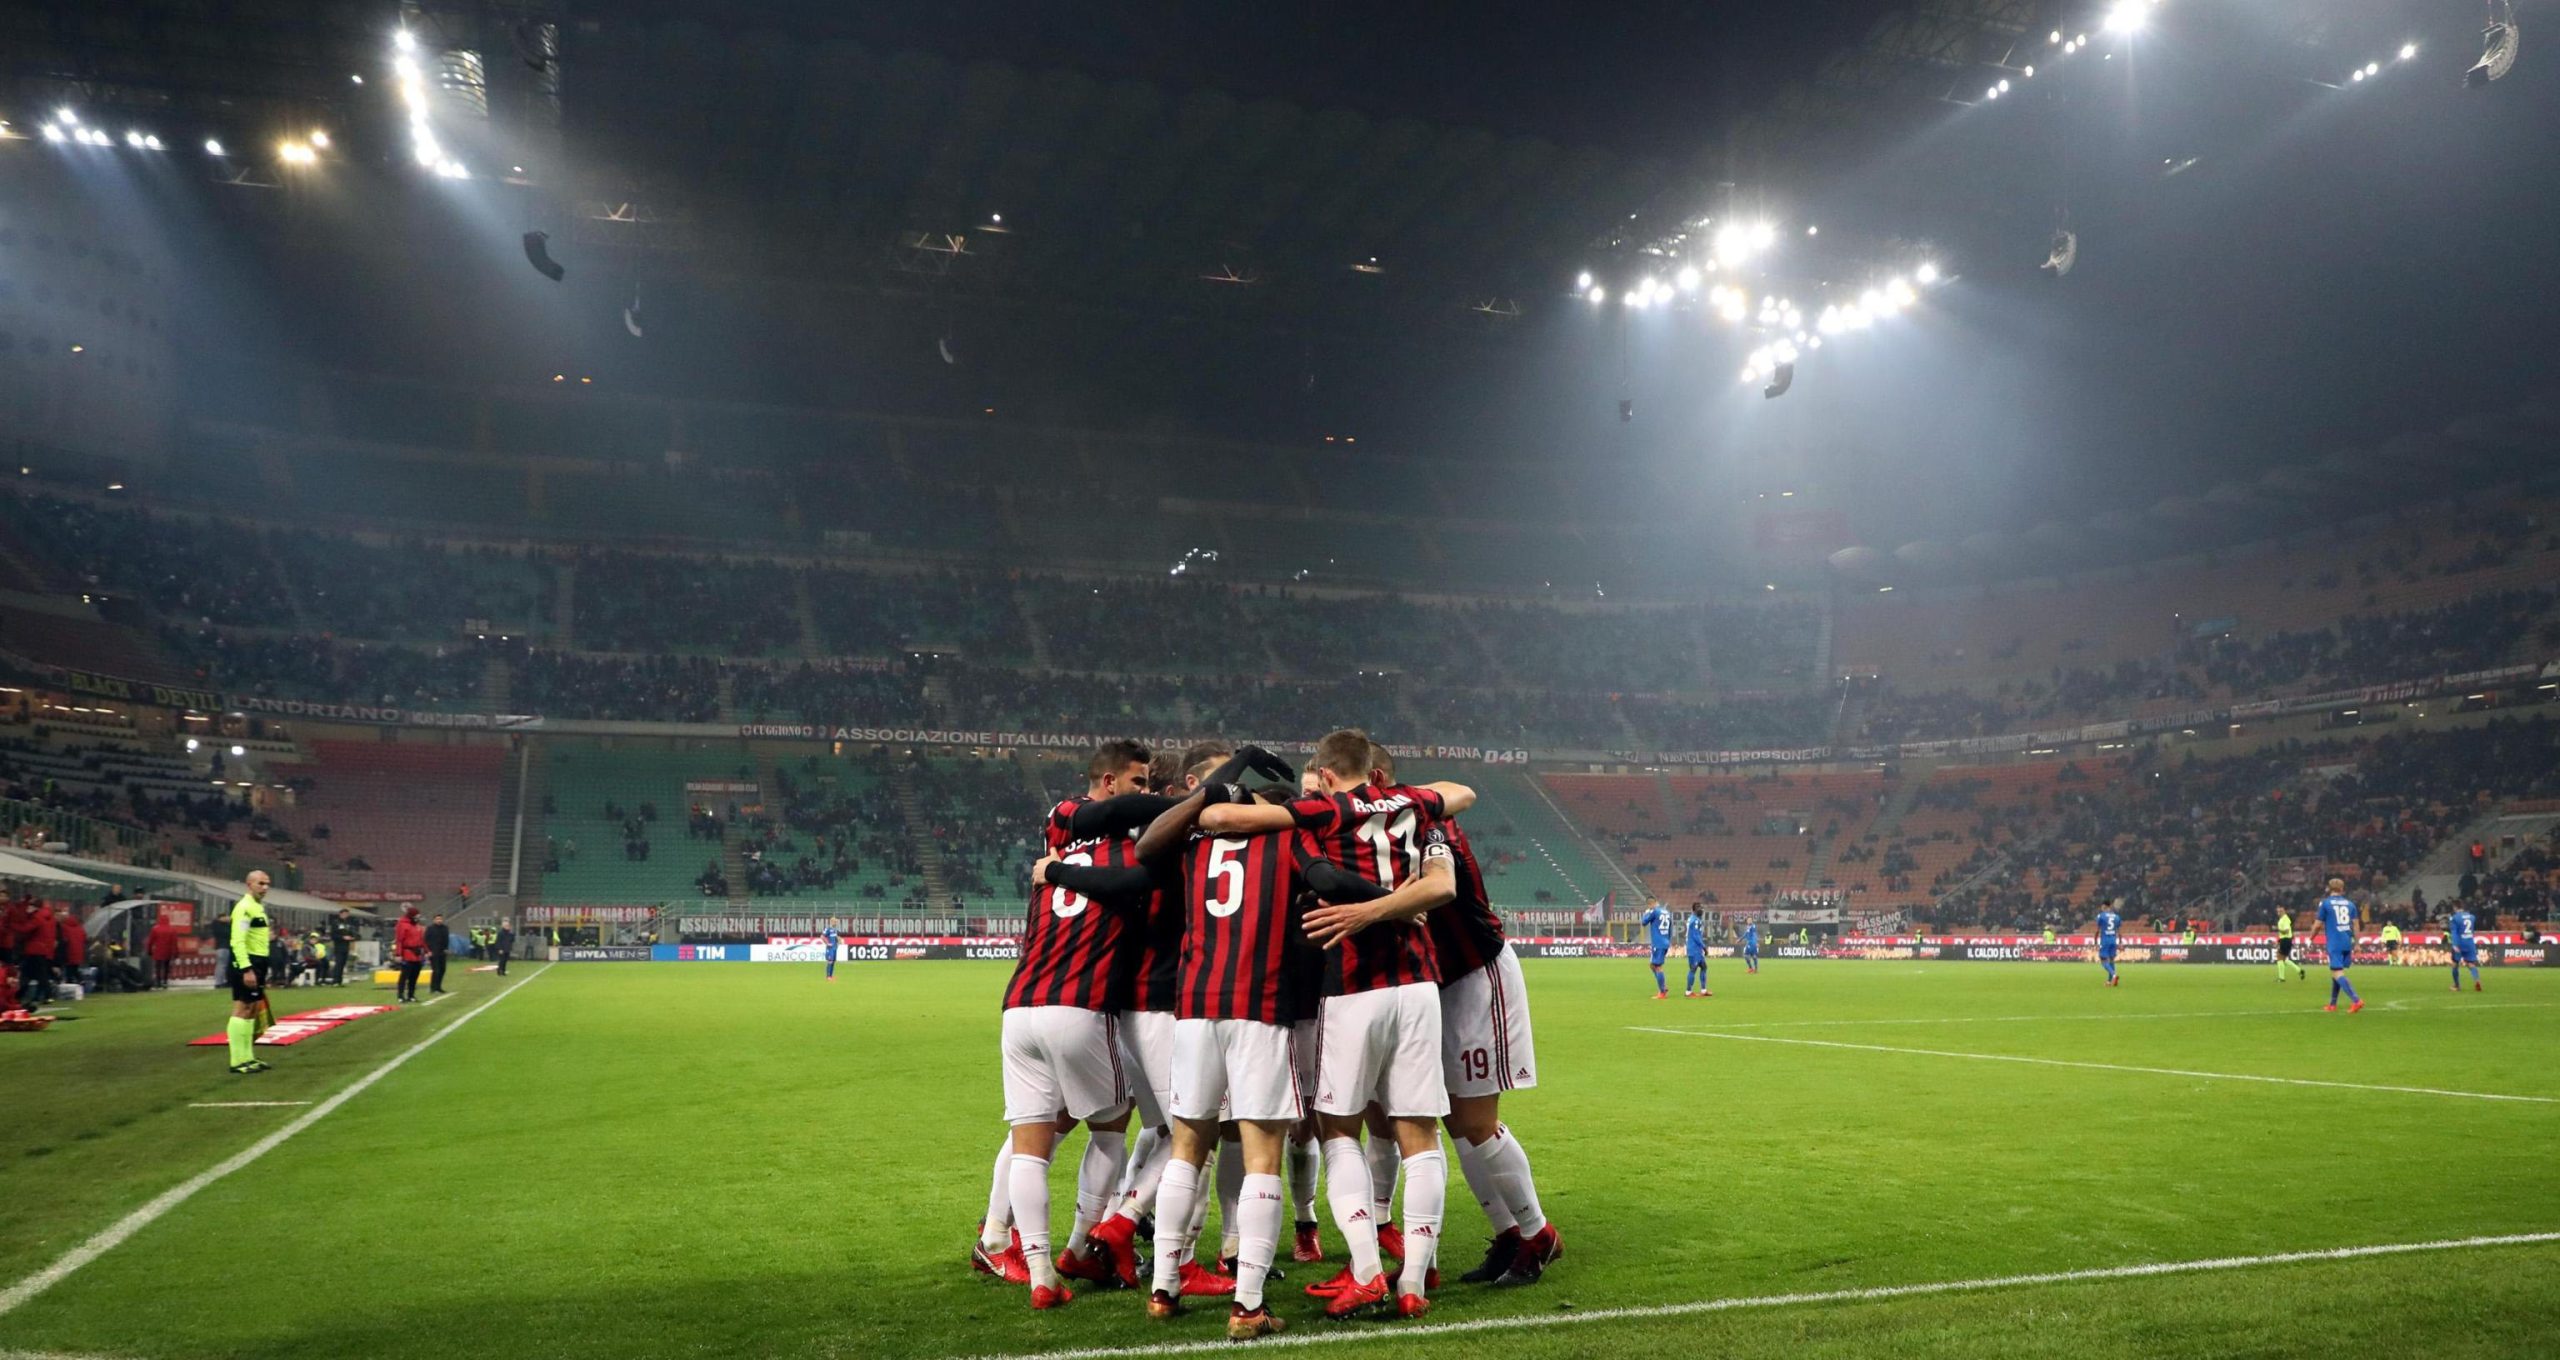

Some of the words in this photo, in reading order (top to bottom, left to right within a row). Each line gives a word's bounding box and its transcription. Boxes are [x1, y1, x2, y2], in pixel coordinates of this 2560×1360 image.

[70, 673, 131, 698] BLACK
[153, 688, 223, 711] DEVIL
[231, 696, 400, 721] LANDRIANO
[752, 725, 802, 737] CUGGIONO
[834, 727, 992, 744] ASSOCIAZIONE
[998, 732, 1091, 747] ITALIANA
[1437, 746, 1482, 759] PAINA
[1356, 808, 1420, 891] 11
[1428, 844, 1445, 857] C
[1205, 838, 1249, 918] 5
[526, 906, 551, 922] CASA
[2333, 905, 2350, 925] 18
[679, 917, 760, 932] ASSOCIAZIONE
[764, 918, 812, 933] ITALIANA
[883, 918, 922, 934] MONDO
[925, 918, 958, 934] MILAN
[1659, 914, 1670, 930] 25
[2107, 917, 2115, 931] 5
[574, 950, 608, 959] NIVEA
[609, 950, 636, 959] MEN
[695, 945, 726, 960] TIM
[768, 951, 807, 961] BANCO
[849, 946, 888, 959] 10:02
[966, 947, 975, 957] IL
[2226, 948, 2236, 961] IL
[2237, 948, 2270, 961] CALCIO
[2504, 949, 2544, 959] PREMIUM
[1460, 1047, 1489, 1082] 19
